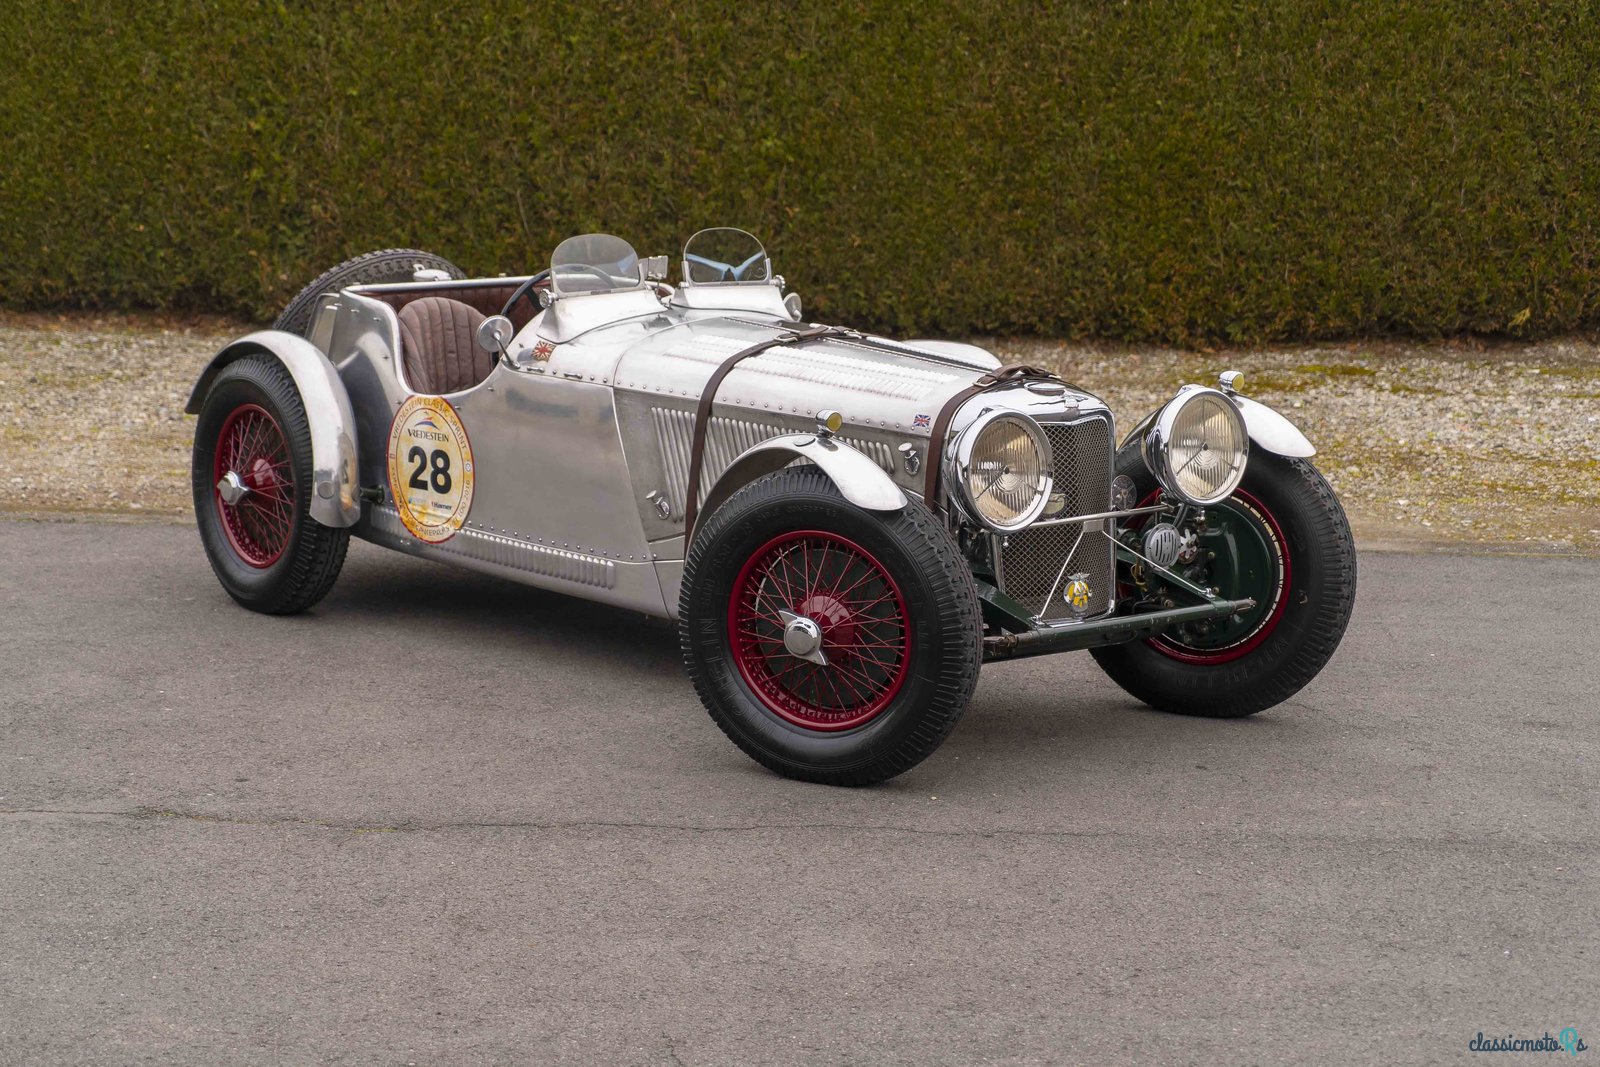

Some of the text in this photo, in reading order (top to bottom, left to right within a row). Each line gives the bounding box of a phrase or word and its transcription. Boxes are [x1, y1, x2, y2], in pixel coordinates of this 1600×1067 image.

[407, 428, 449, 442] VREDESTEIN
[449, 416, 467, 449] SPRINT
[408, 445, 452, 495] 28
